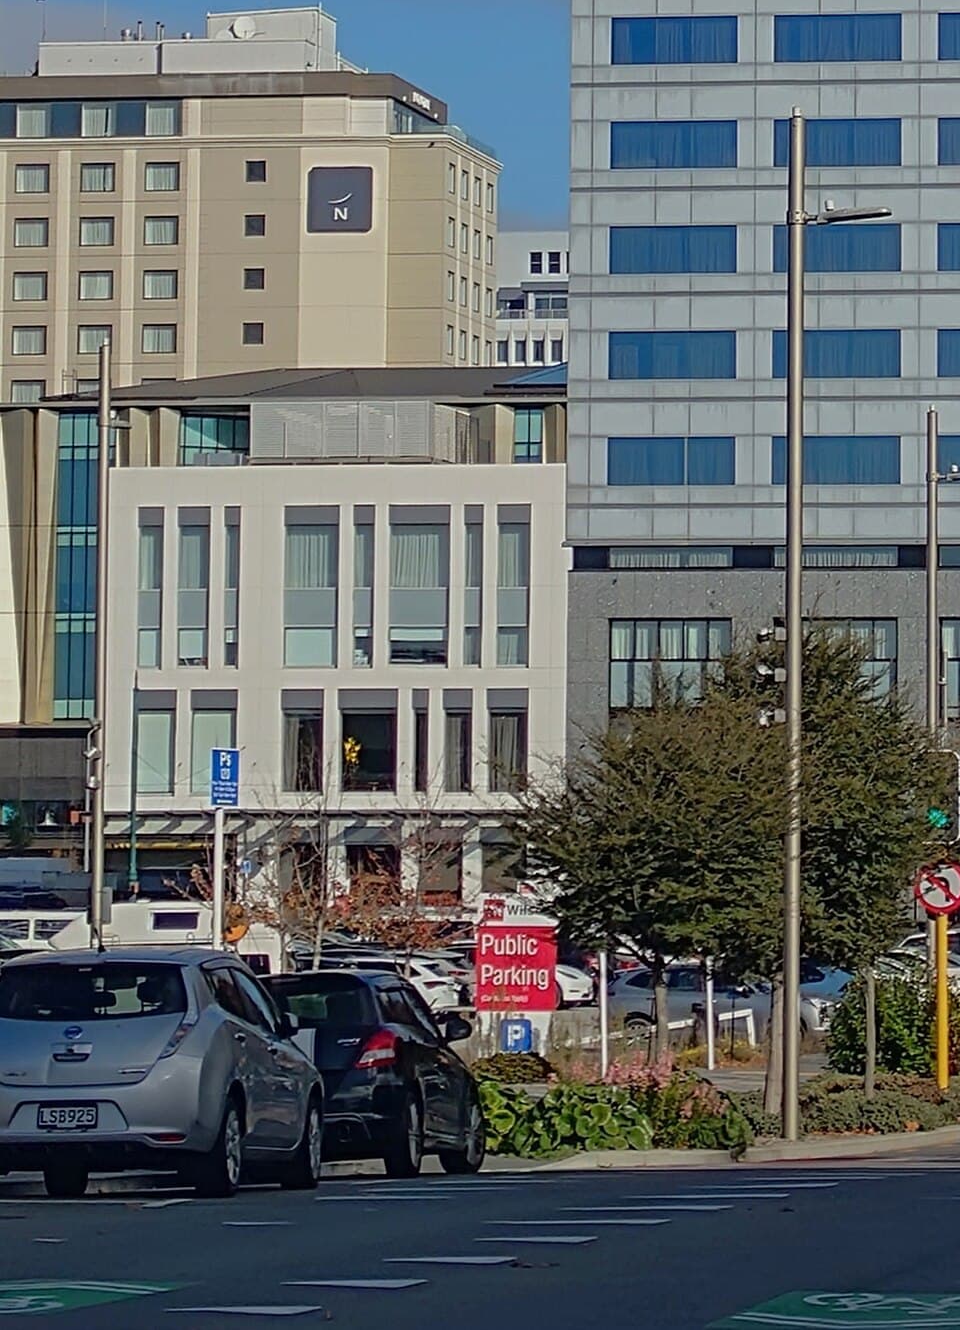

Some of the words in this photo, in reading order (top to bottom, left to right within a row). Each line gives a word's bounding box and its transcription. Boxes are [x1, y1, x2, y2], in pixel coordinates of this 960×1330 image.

[334, 207, 348, 221] N
[481, 933, 538, 956] Public
[481, 964, 549, 990] Parking
[507, 1024, 525, 1047] P
[40, 1109, 95, 1124] LSB925
